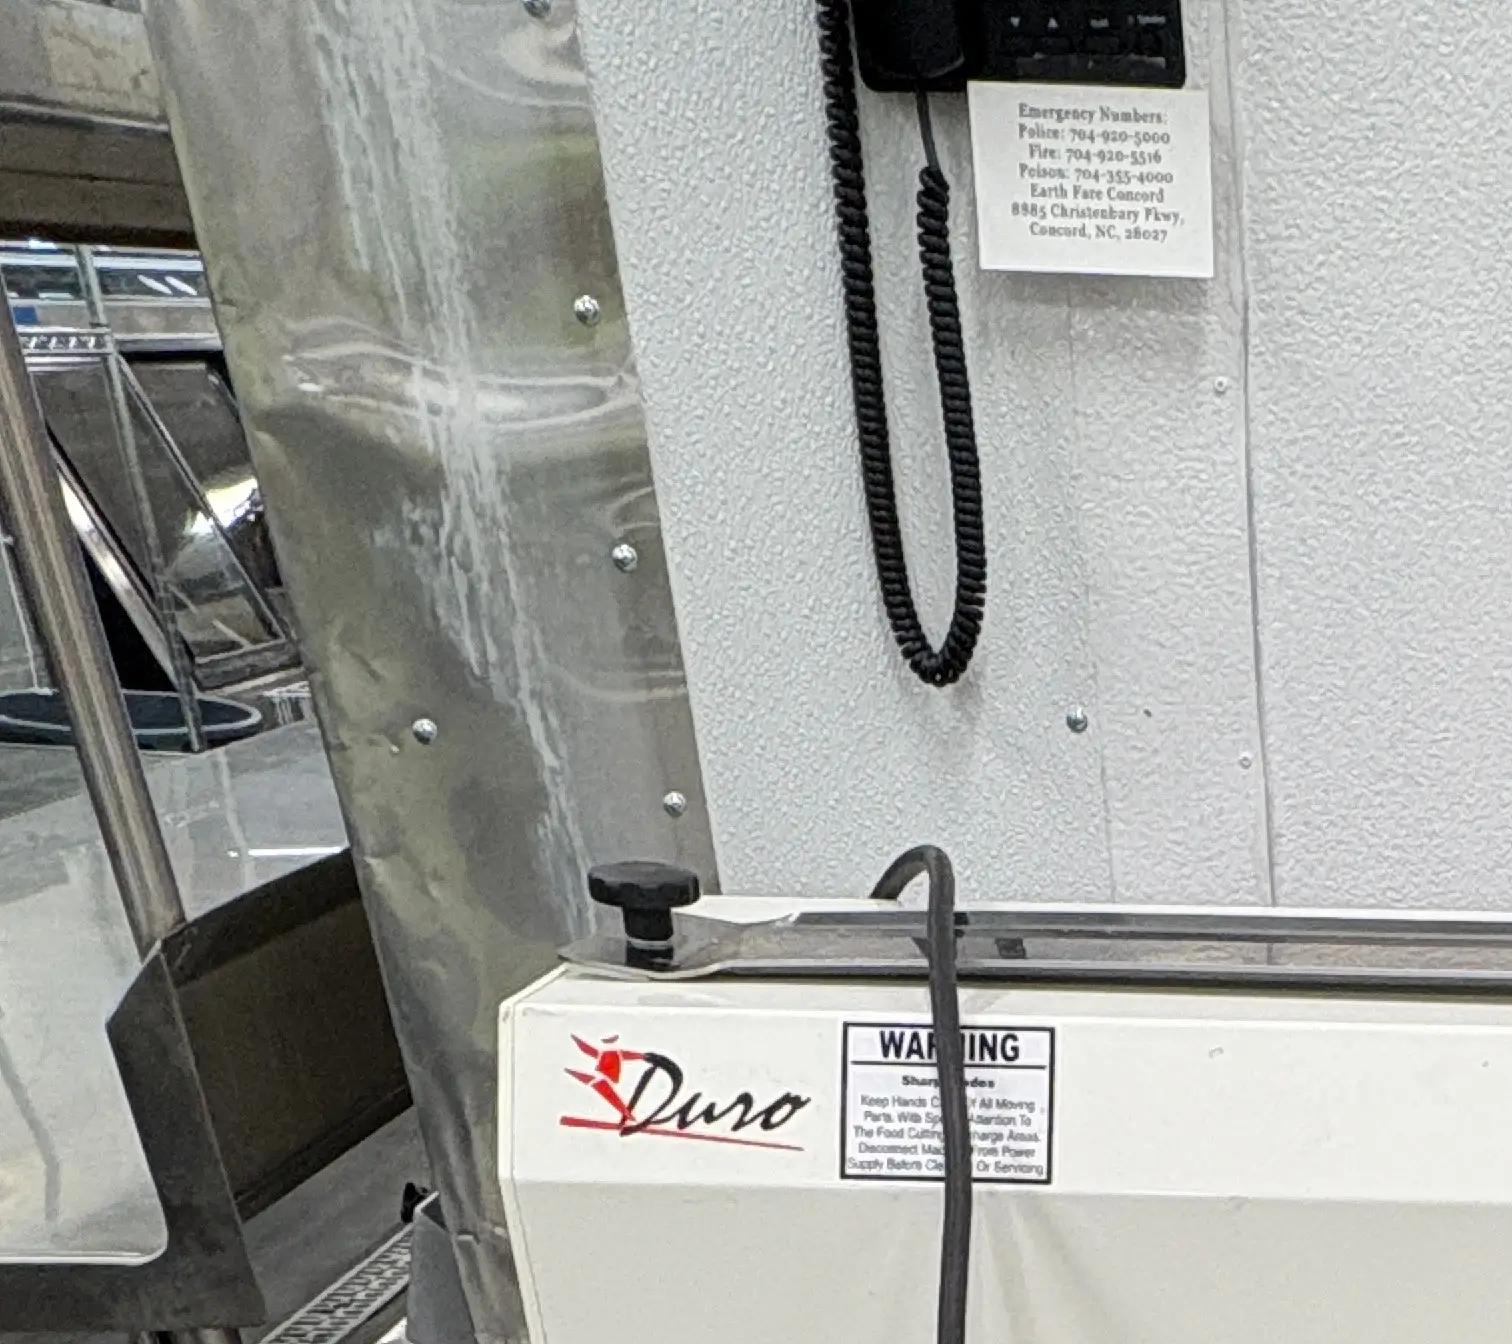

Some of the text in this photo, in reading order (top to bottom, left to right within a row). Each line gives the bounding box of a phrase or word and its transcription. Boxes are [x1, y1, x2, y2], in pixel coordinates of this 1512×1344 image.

[1018, 102, 1095, 123] Emergency
[1018, 122, 1171, 147] Police: 704-920-5000
[1029, 142, 1162, 166] Fire: 704-920-5516
[1018, 162, 1174, 185] Poison: 704-355-4000
[1030, 183, 1165, 203] Earth Fare Concord
[1050, 203, 1140, 225] Christenbury
[1144, 206, 1185, 226] Pkwy,
[1029, 221, 1168, 243] Concord, NC, 28027
[618, 1052, 812, 1137] Duro
[853, 1125, 874, 1138] The
